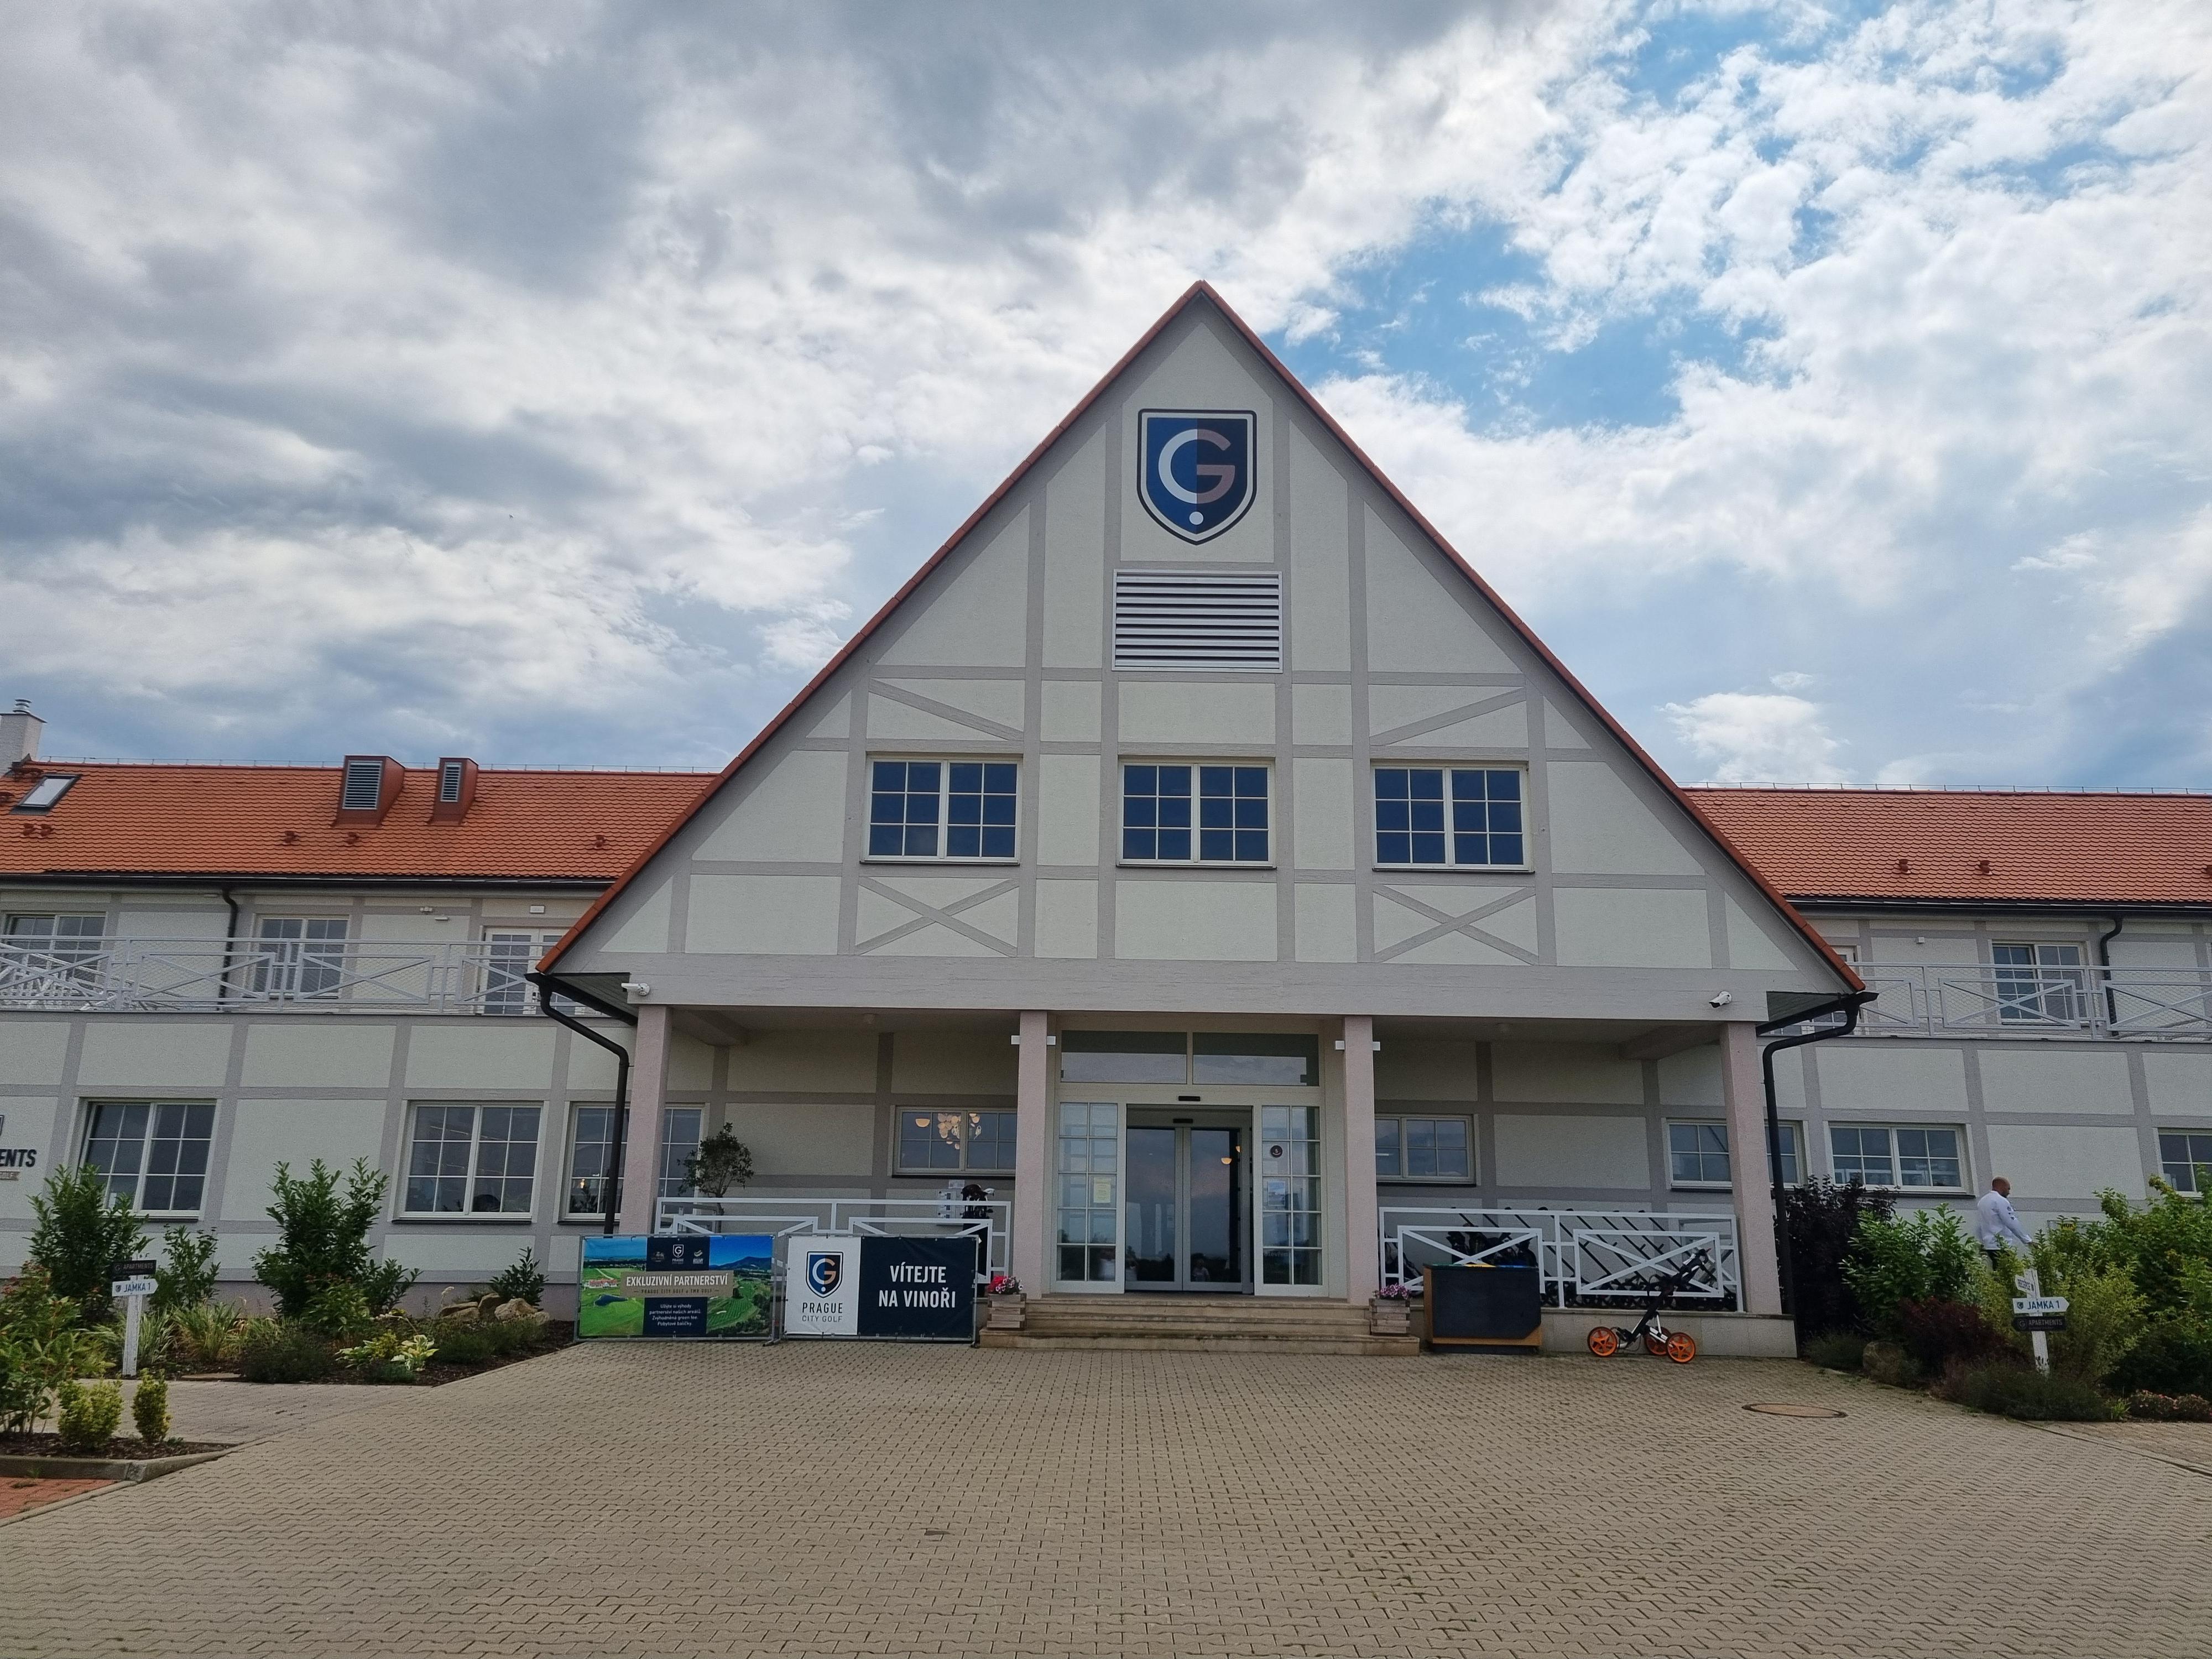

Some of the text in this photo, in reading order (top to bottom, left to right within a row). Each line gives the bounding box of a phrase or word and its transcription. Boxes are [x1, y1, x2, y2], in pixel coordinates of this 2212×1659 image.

[890, 1261, 947, 1283] VÍTEJTE
[626, 1273, 728, 1286] EXKLUZIVNÍ PARTNERSTVÍ
[123, 1282, 151, 1292] JAMKA 1
[879, 1287, 956, 1308] NA VINOŘI
[802, 1302, 843, 1313] PRAGUE
[2027, 1300, 2060, 1310] JAMKA 1
